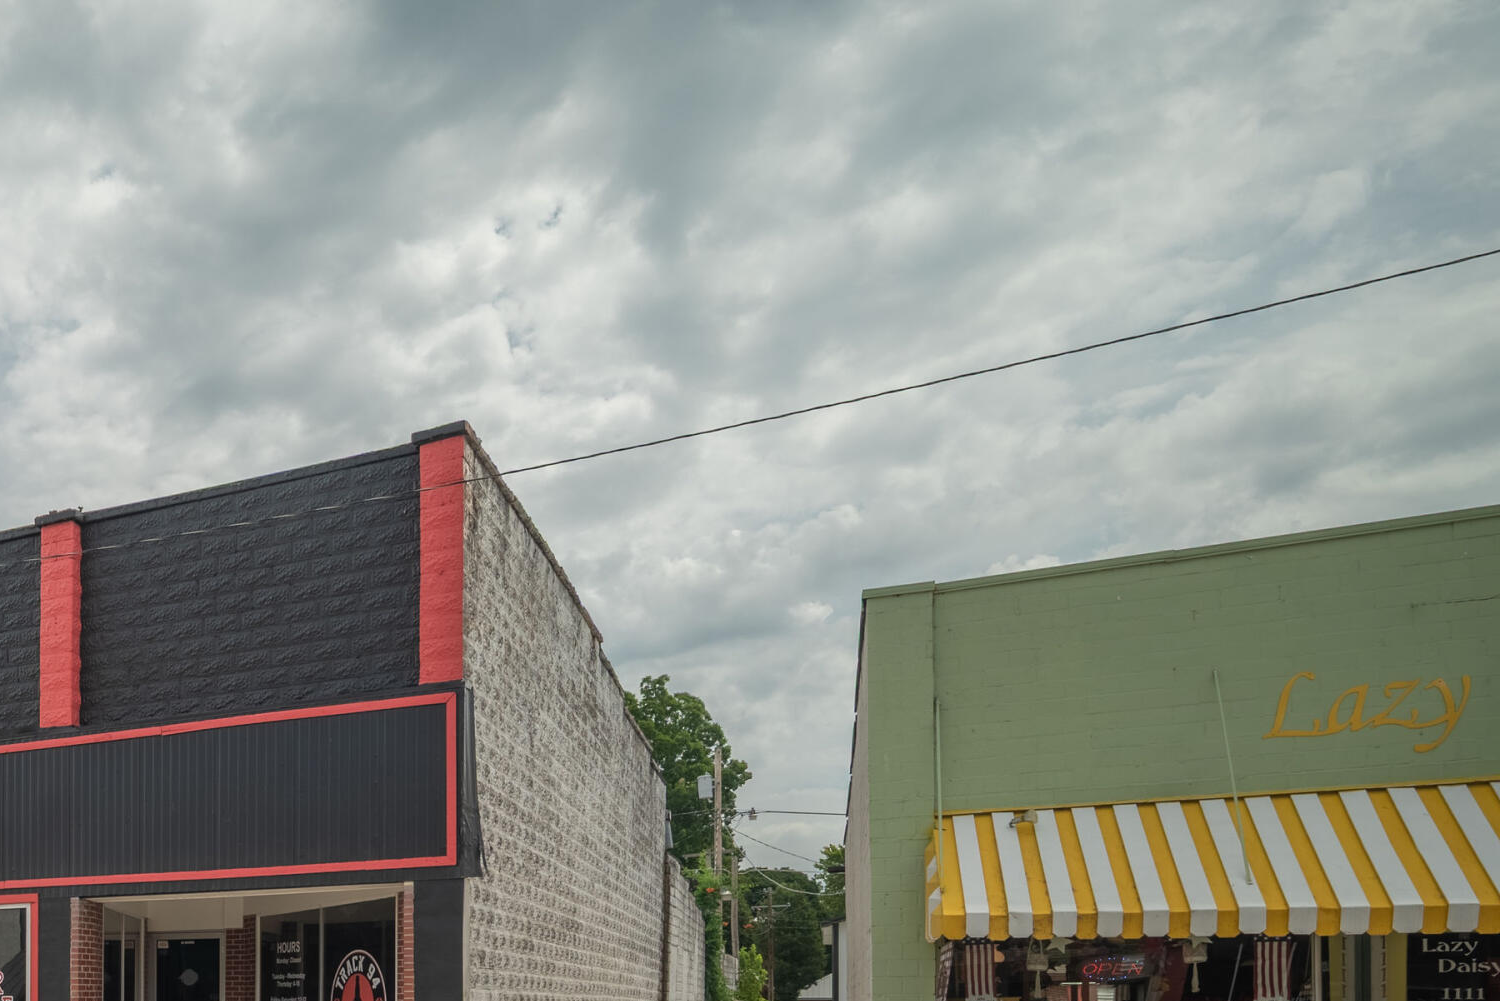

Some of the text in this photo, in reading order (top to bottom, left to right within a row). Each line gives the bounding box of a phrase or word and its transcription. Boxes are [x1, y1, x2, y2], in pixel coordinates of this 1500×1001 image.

[1262, 671, 1471, 752] Lazy
[277, 942, 300, 953] HOURS
[1422, 938, 1478, 956] Lazy
[335, 955, 380, 990] TRACK 94
[1082, 962, 1144, 976] OPEN
[1438, 958, 1500, 977] Daisy
[1443, 987, 1485, 1000] 1111
